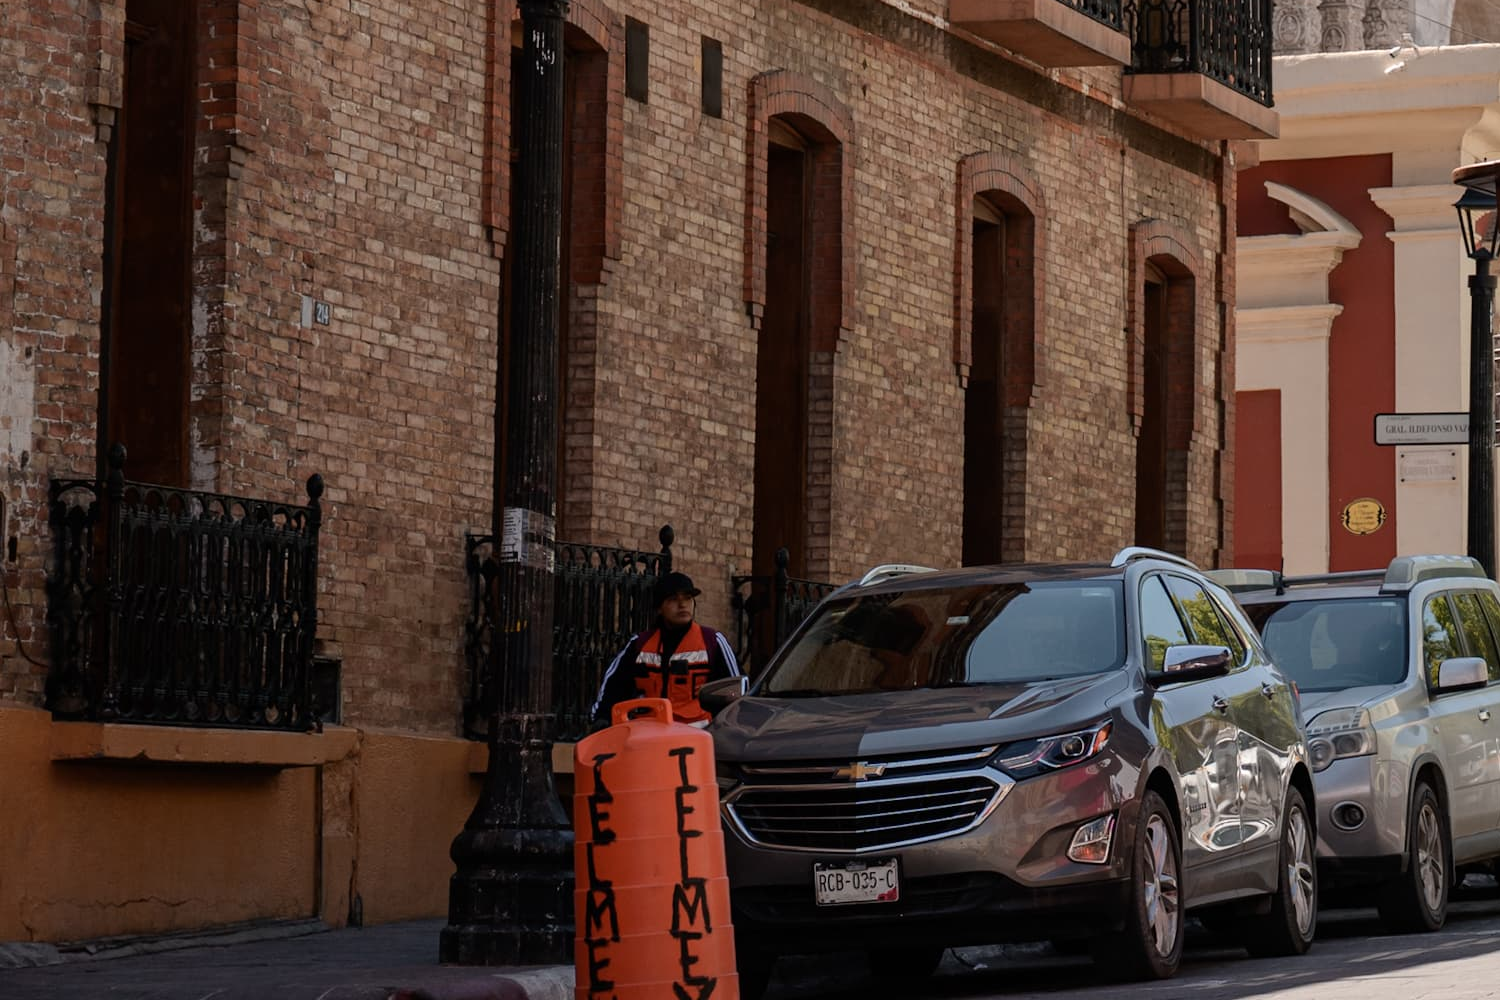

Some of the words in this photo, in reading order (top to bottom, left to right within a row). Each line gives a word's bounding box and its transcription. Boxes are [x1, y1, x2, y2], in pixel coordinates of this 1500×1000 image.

[317, 303, 328, 324] 214
[1385, 424, 1407, 434] GRAL.
[1408, 424, 1452, 434] ILDEFONSO
[1453, 423, 1469, 433] VAZ
[584, 753, 620, 1000] TELME
[819, 869, 894, 893] RCB-035-C
